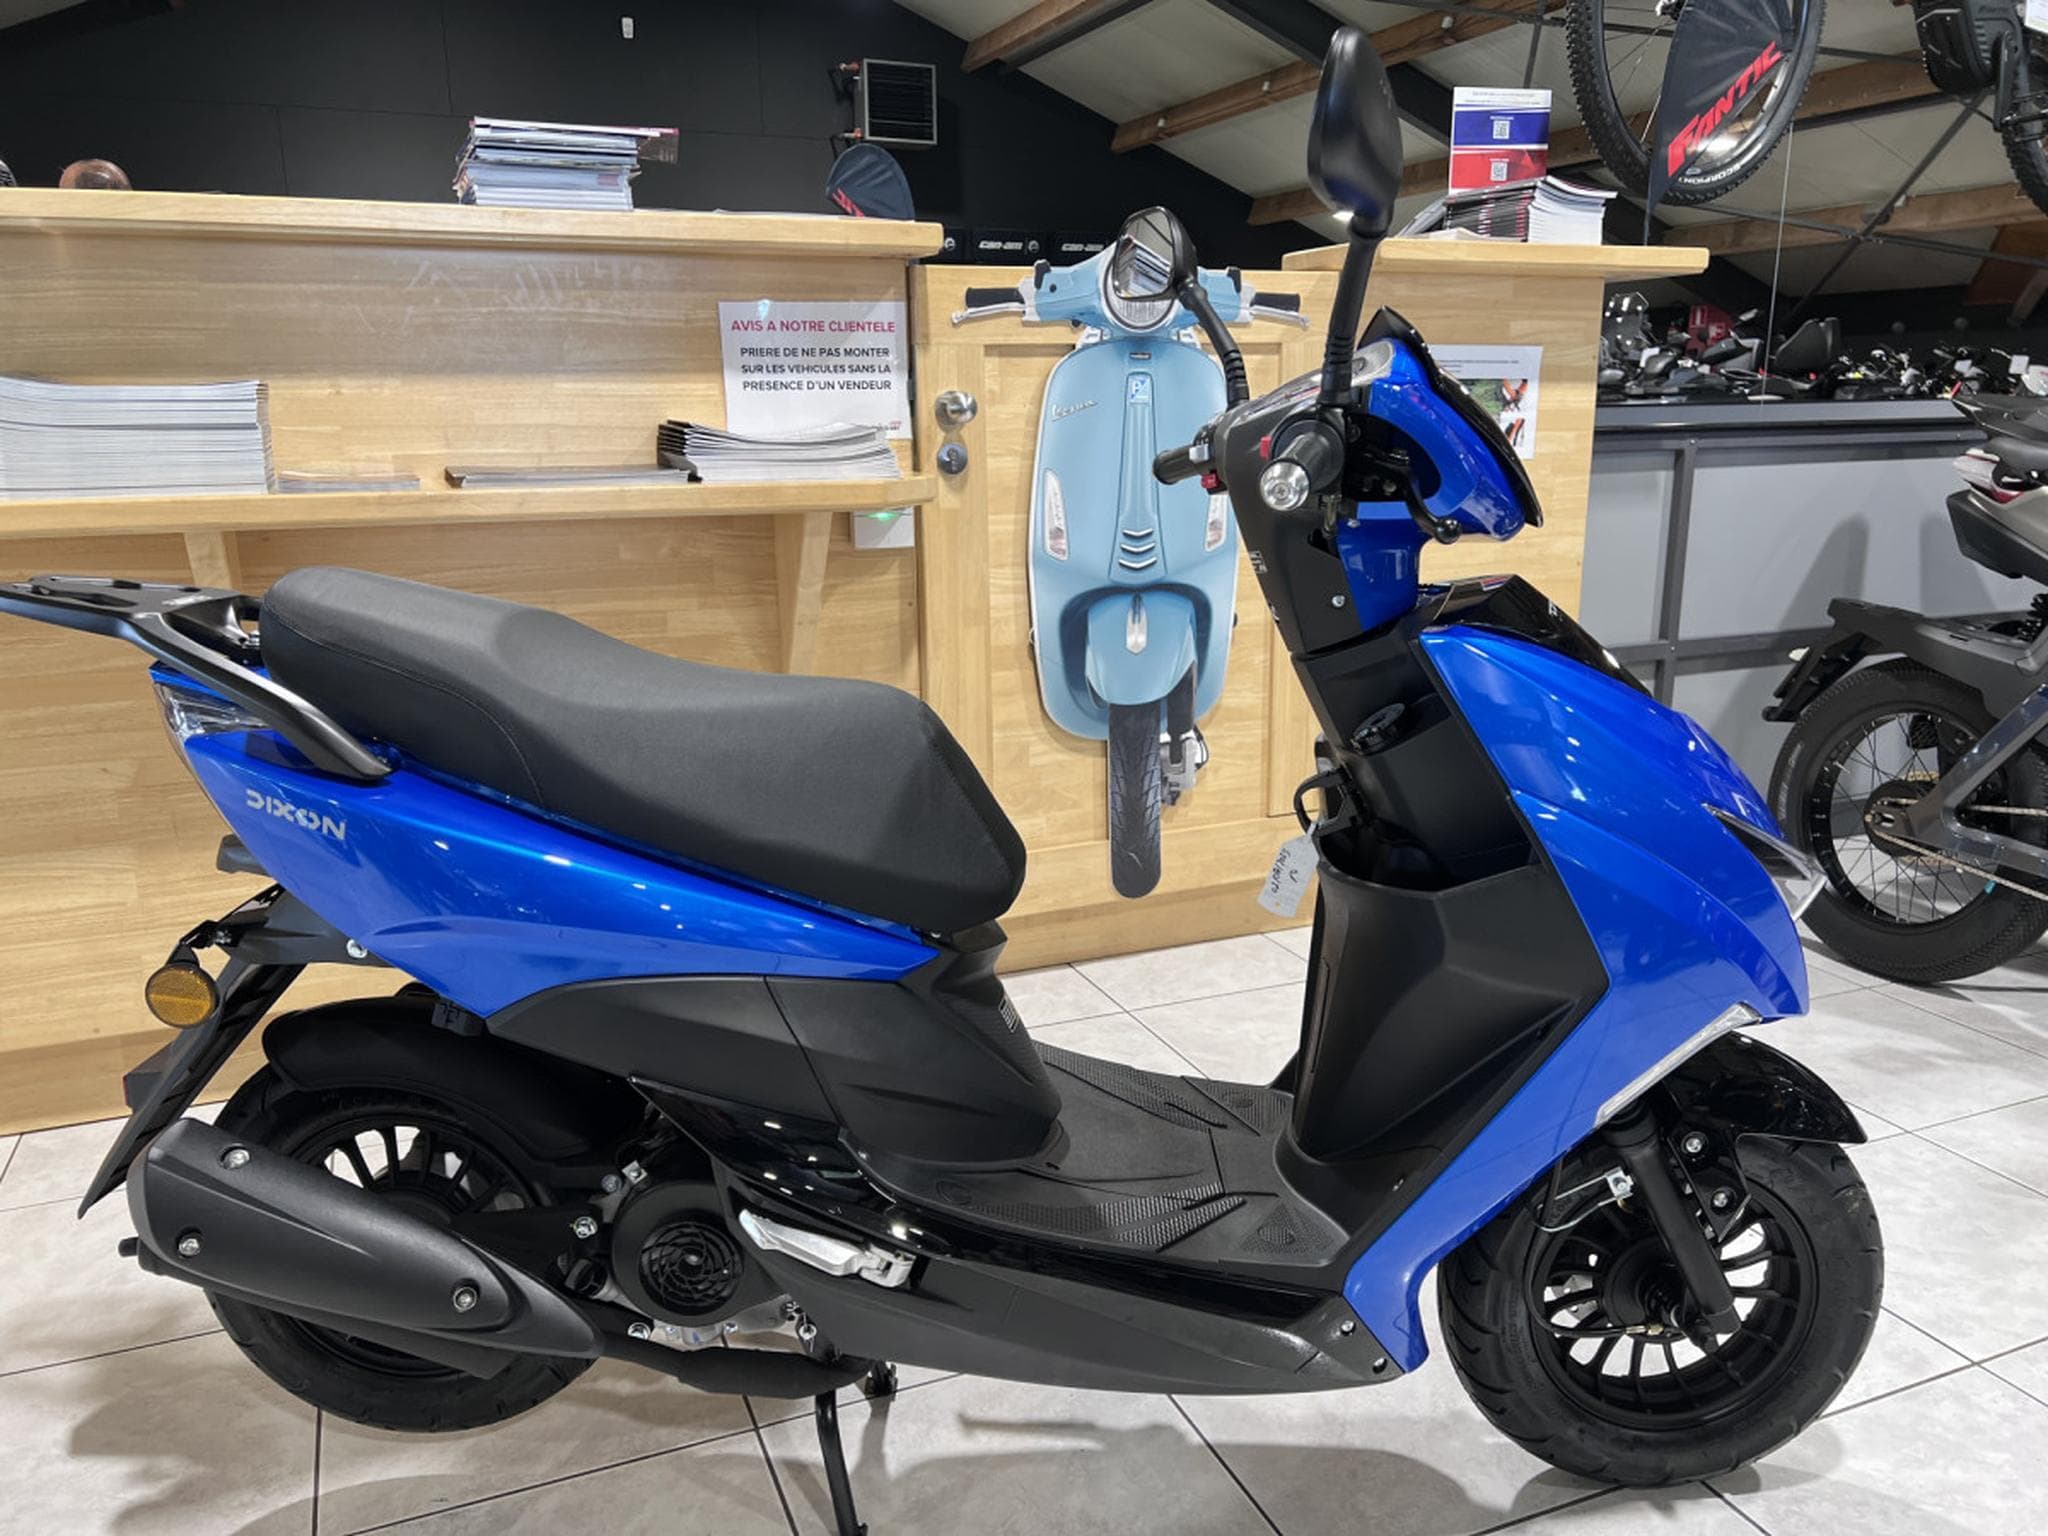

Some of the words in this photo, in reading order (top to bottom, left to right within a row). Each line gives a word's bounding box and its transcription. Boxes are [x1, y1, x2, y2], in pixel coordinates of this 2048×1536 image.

[1668, 40, 1784, 177] FANTIC
[731, 320, 763, 332] AVIS
[766, 320, 777, 332] A
[780, 320, 825, 332] NOTRE
[828, 321, 896, 333] CLIENTELE
[740, 347, 780, 358] PRIERE
[783, 347, 799, 358] DE
[801, 347, 816, 358] NE
[819, 347, 841, 358] PAS
[844, 347, 890, 358] MONTER
[741, 363, 764, 374] SUR
[766, 363, 785, 374] LES
[787, 363, 846, 374] VEHICULES
[847, 363, 876, 374] SANS
[878, 363, 892, 374] LA
[743, 380, 803, 391] PRESENCE
[806, 380, 835, 391] D'UN
[837, 380, 892, 391] VENDEUR
[245, 788, 346, 841] DIXON
